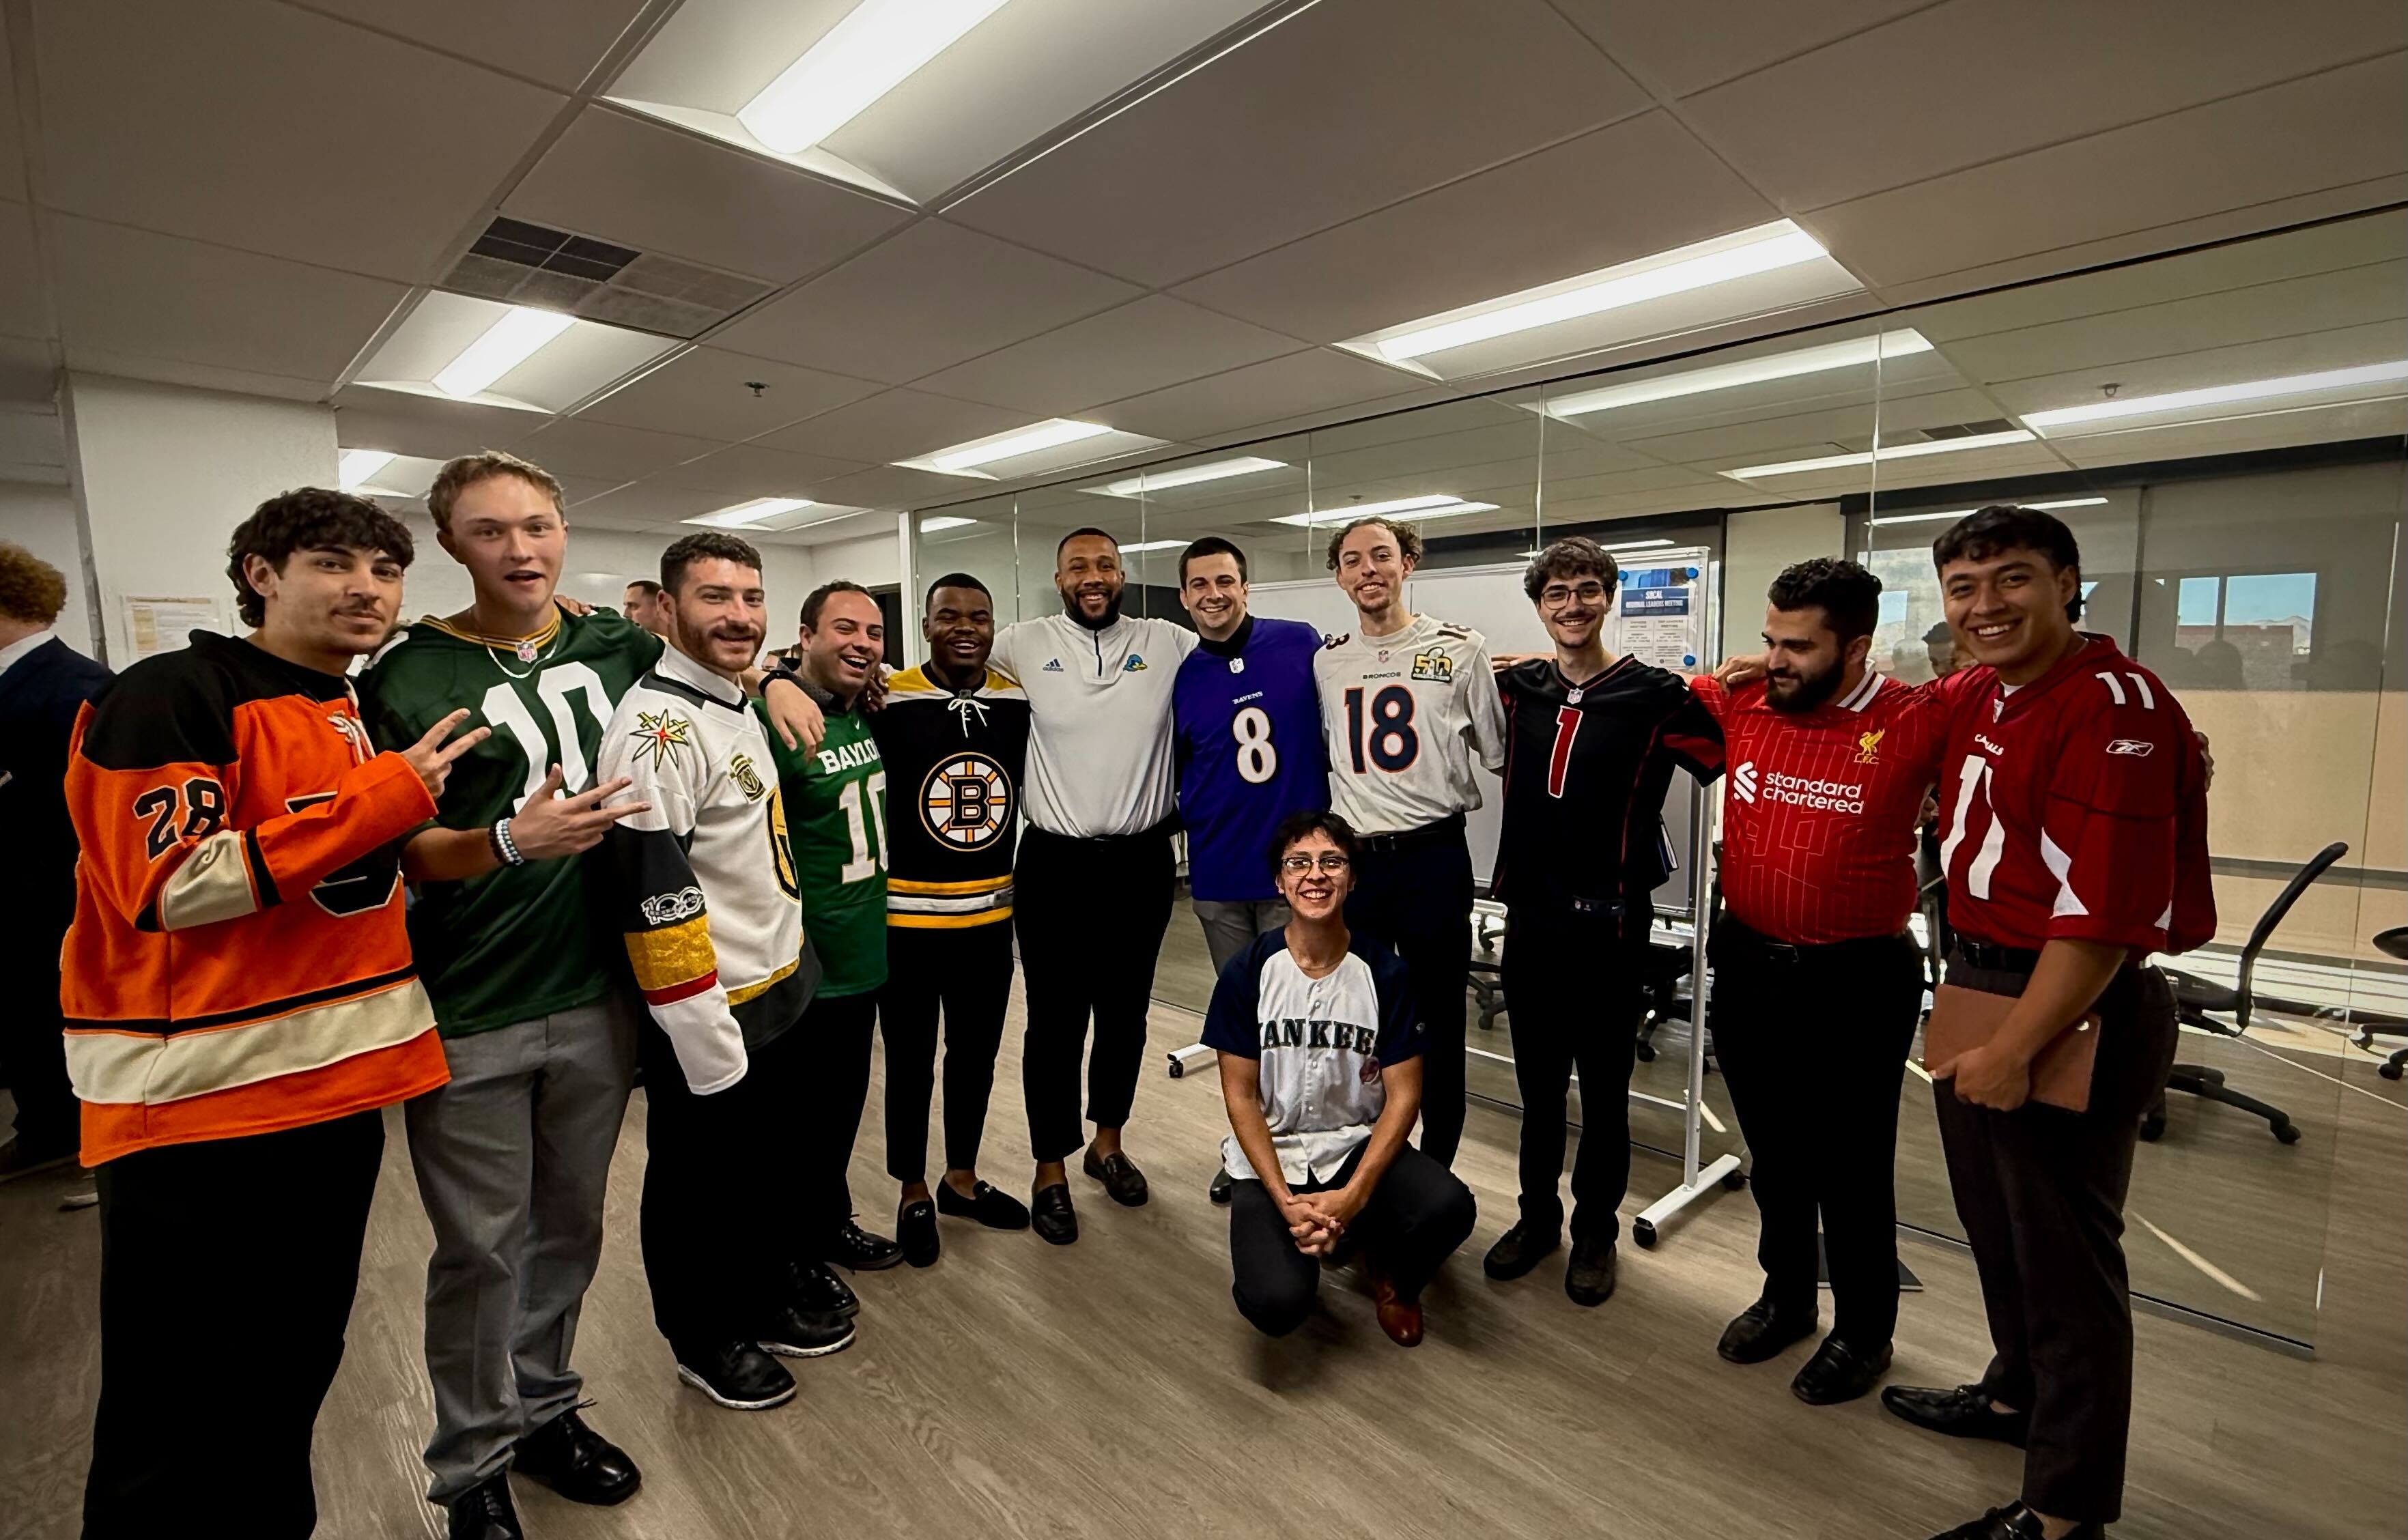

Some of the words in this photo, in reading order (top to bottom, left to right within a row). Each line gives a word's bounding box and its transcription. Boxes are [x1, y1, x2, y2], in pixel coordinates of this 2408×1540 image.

[1232, 691, 1263, 704] RAVENS
[2095, 672, 2155, 710] 11
[481, 661, 614, 815] 10
[1232, 707, 1277, 784] 8
[1344, 684, 1419, 774] 18
[1548, 705, 1584, 799] 1
[948, 776, 991, 829] B
[1762, 787, 1865, 814] chartered
[1765, 771, 1862, 799] standard
[132, 776, 227, 864] 28
[1258, 1018, 1376, 1056] ANKEE
